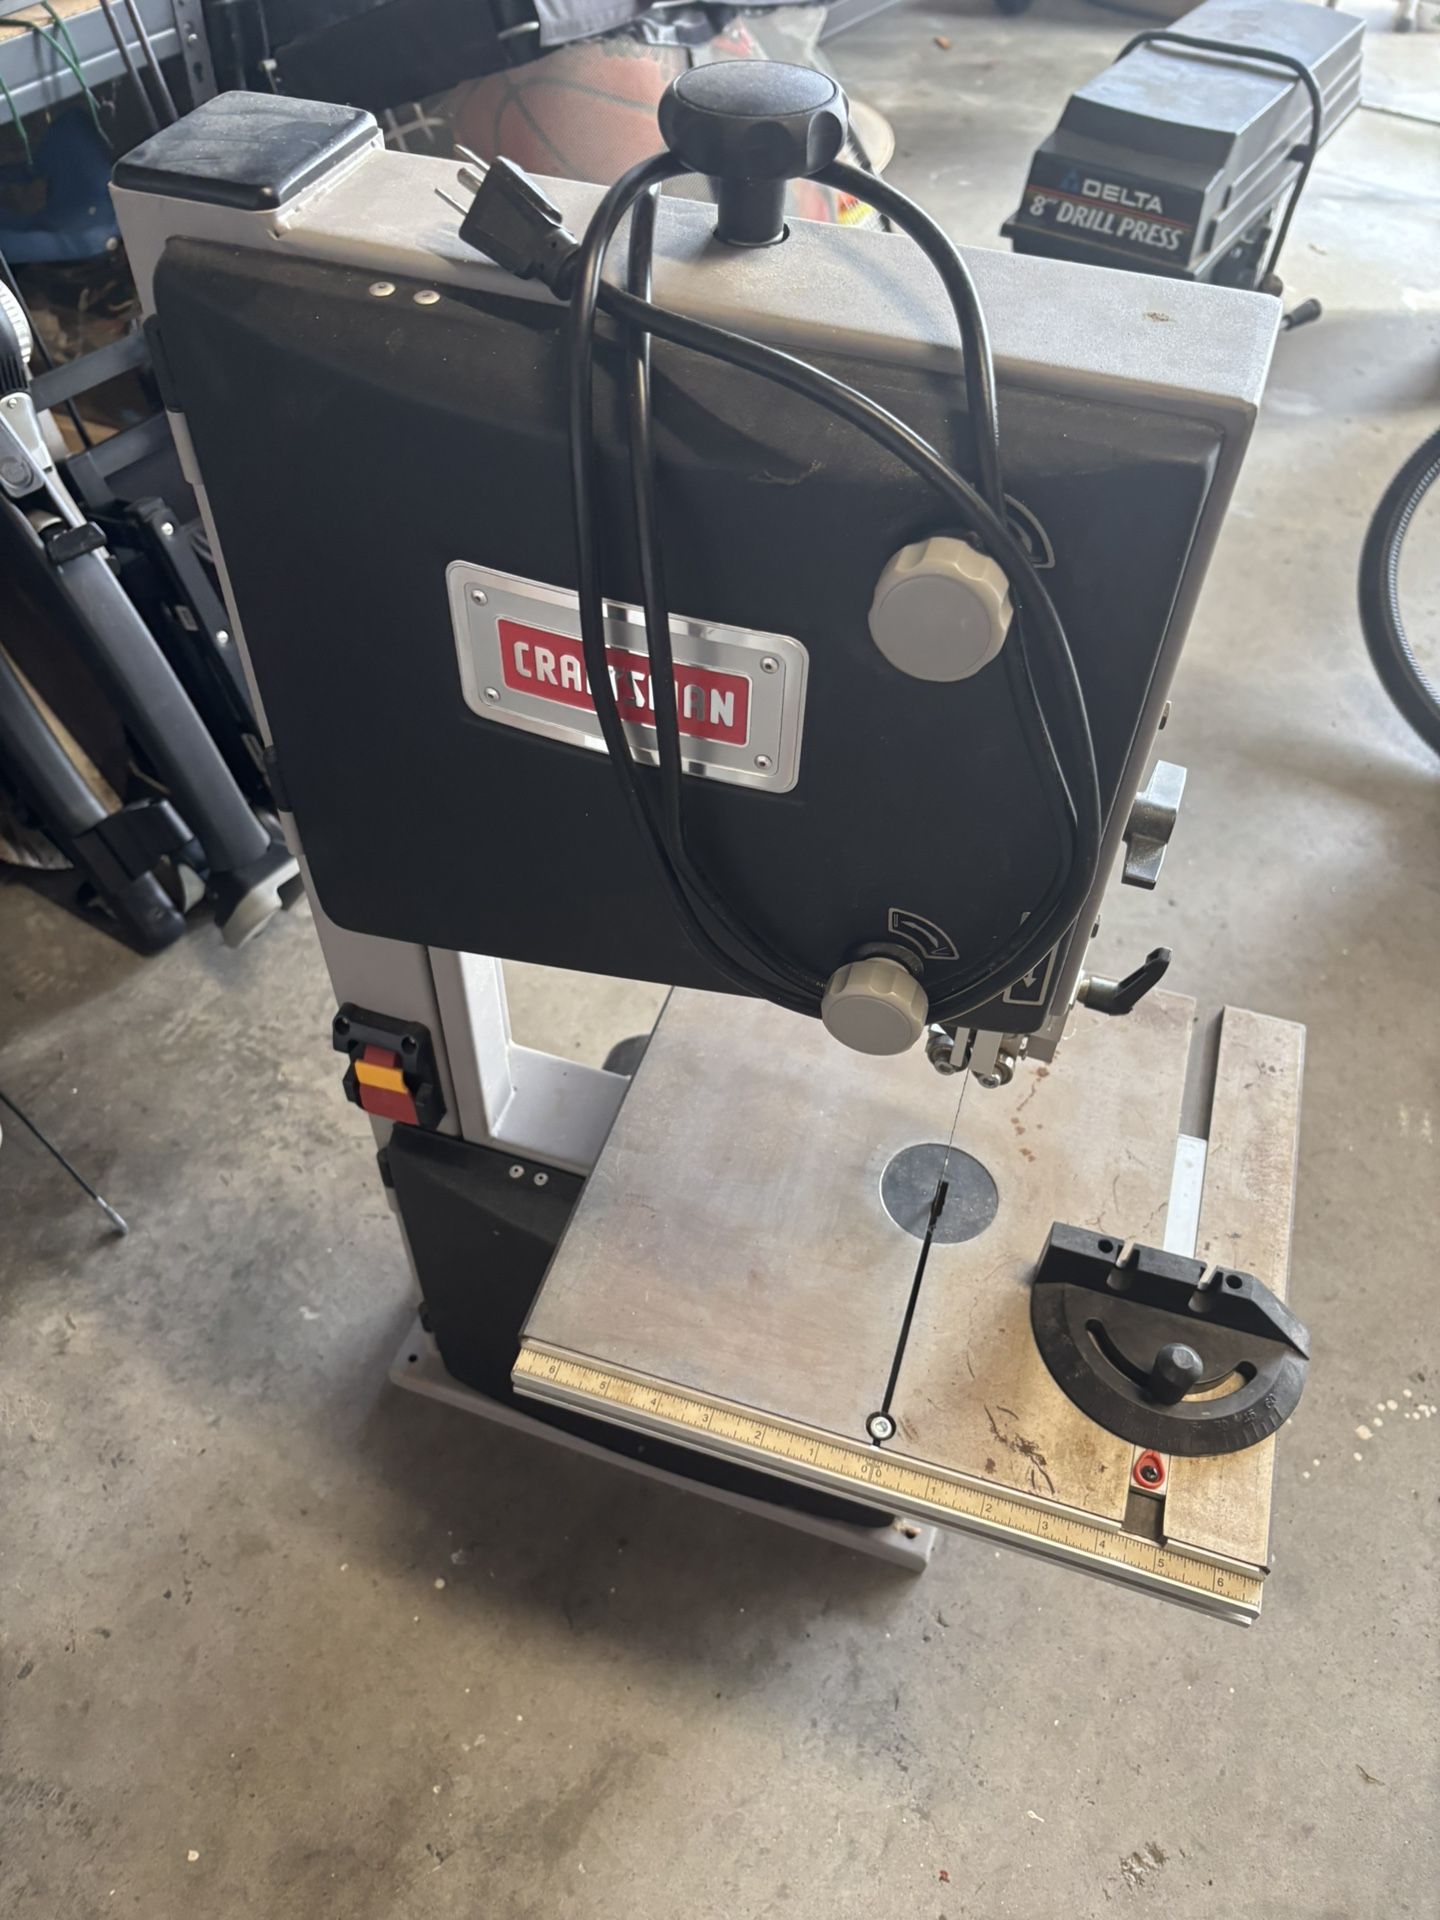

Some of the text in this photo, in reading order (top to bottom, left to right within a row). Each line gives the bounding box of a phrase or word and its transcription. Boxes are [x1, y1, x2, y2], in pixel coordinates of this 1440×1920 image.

[1057, 203, 1114, 236] DRILL
[1116, 217, 1182, 250] PRESS
[1082, 179, 1163, 213] DELTA
[514, 641, 735, 727] CRATSAN
[548, 1365, 1225, 1588] 6 5 4 3 2 1 0 0 1 2 3 4 5 6
